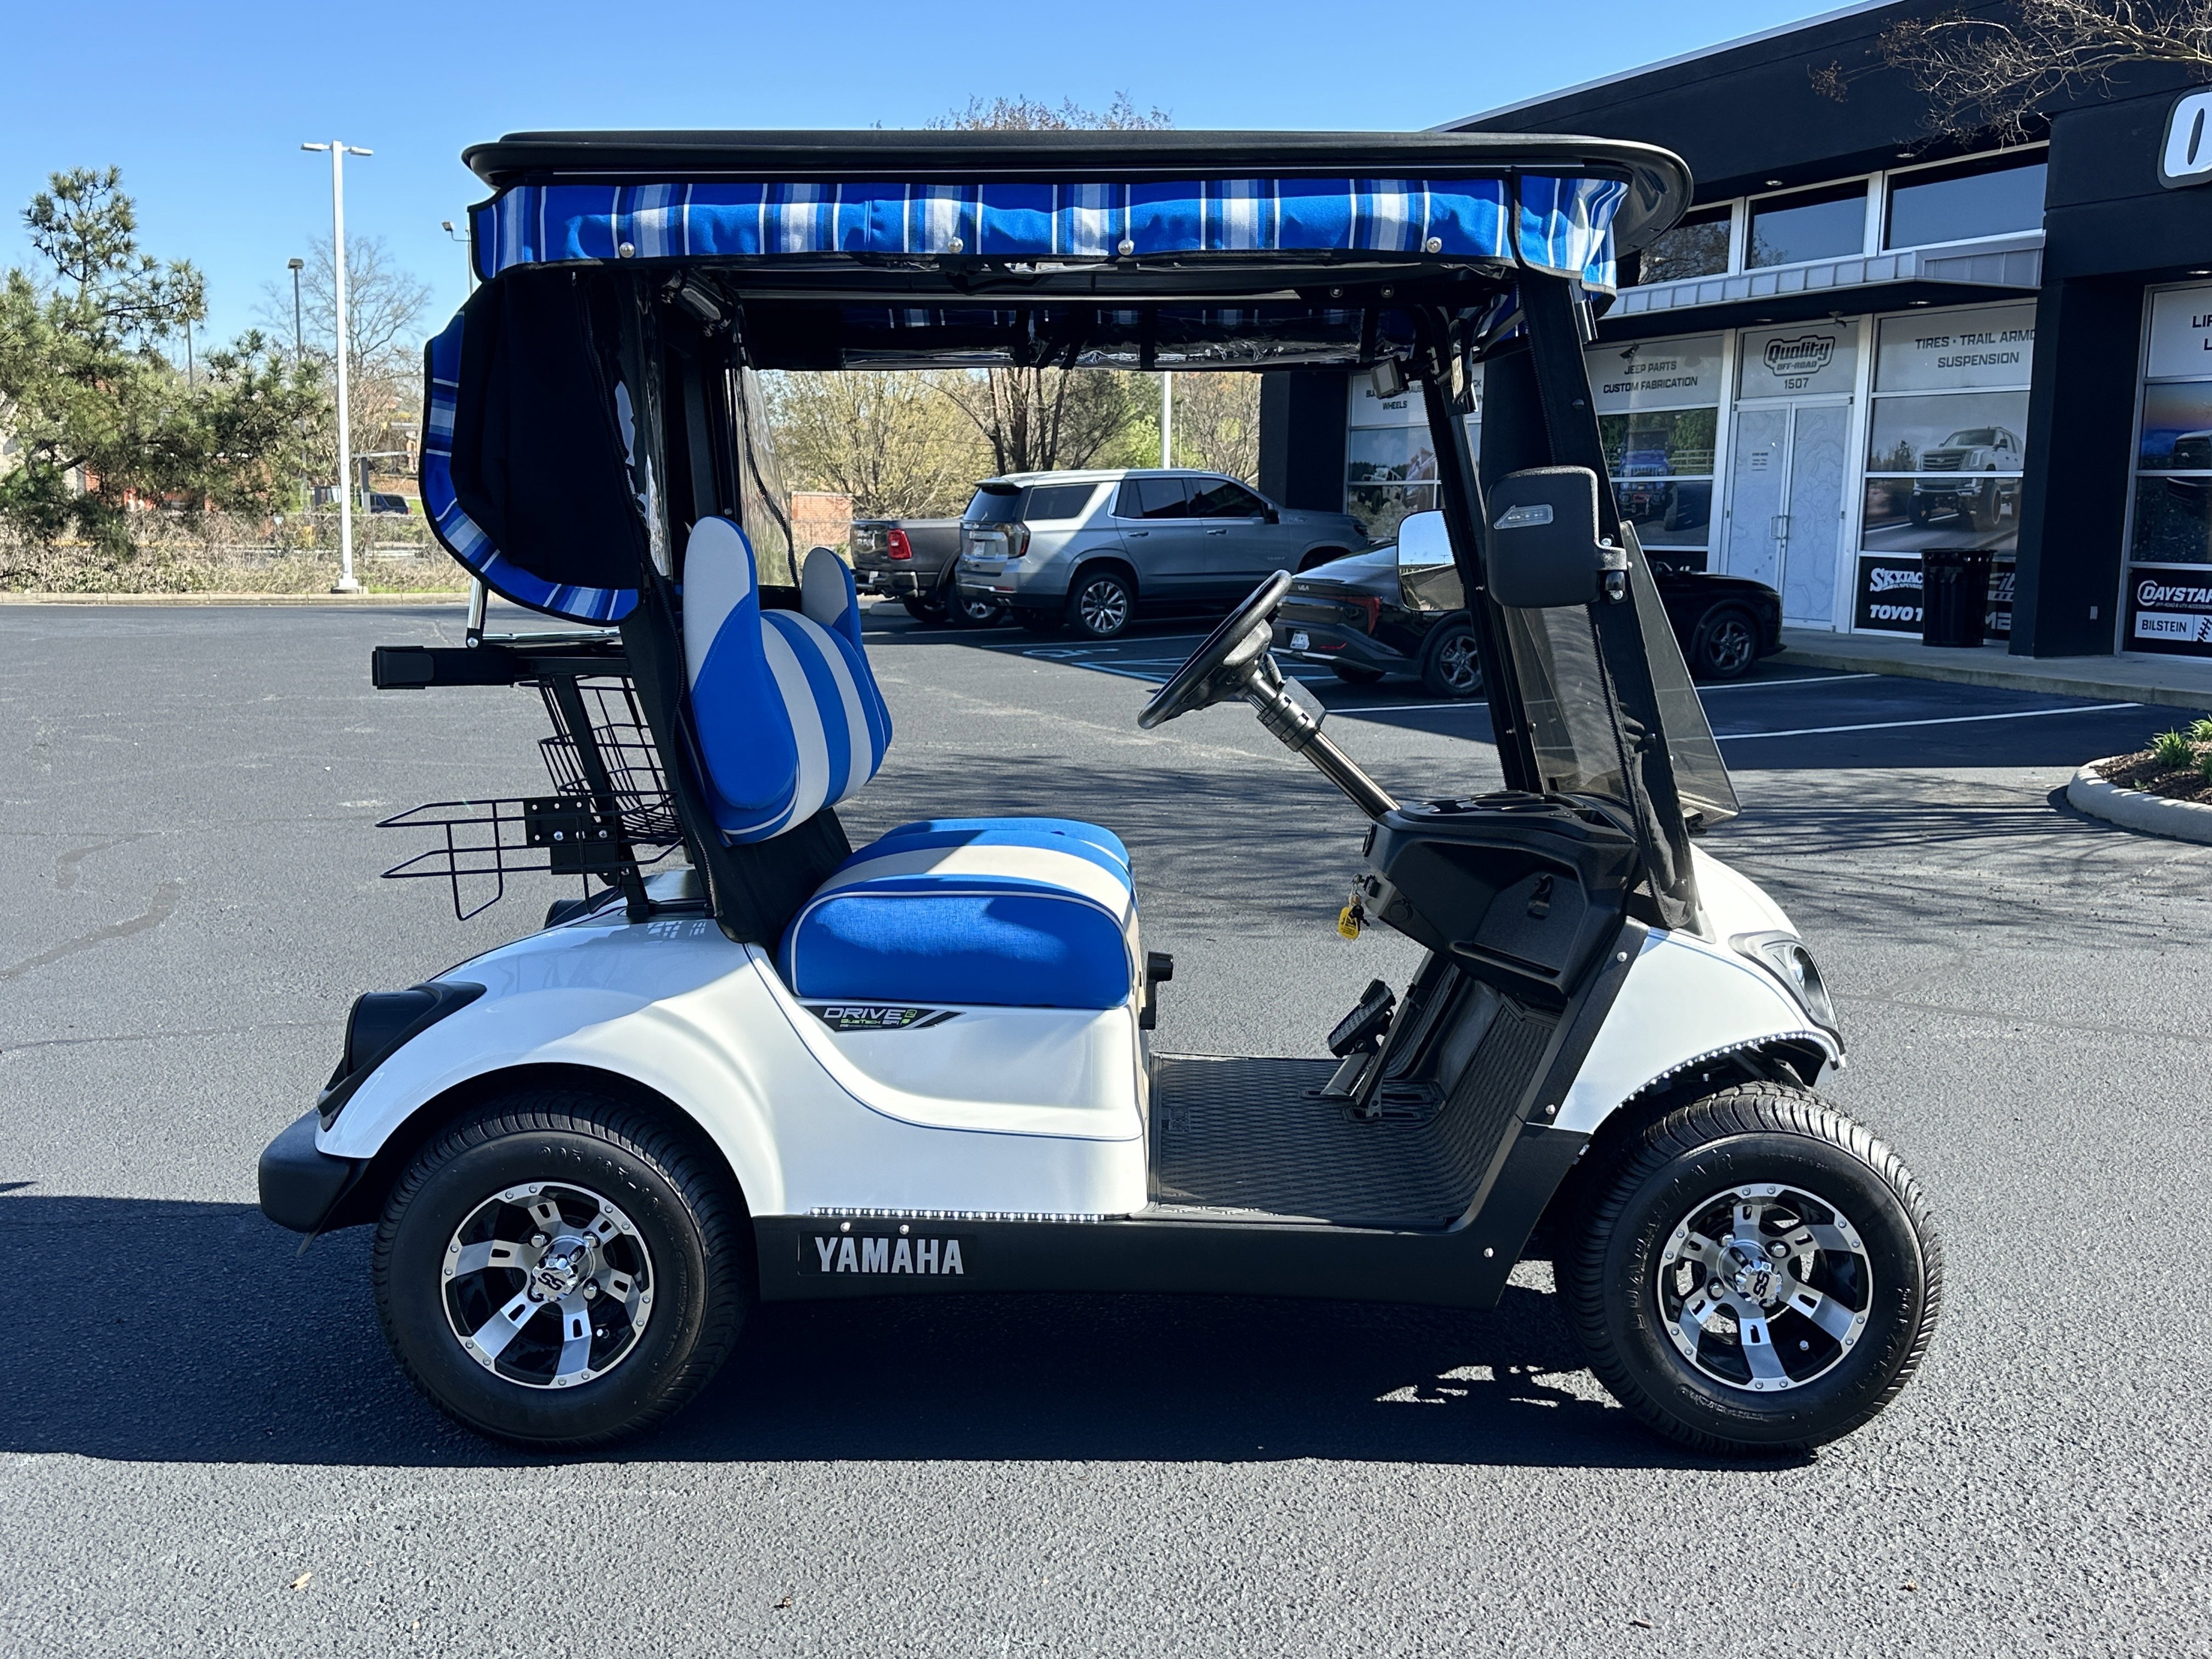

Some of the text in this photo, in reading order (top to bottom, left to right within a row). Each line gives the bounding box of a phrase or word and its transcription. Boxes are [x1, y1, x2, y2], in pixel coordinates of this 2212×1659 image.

[1915, 336, 1949, 349] TIRES
[1960, 332, 1995, 346] TRAIL
[1768, 342, 1830, 363] Quality
[1938, 352, 2019, 368] SUSPENSION
[1624, 361, 1677, 375] JEEP PARTS
[1777, 360, 1817, 370] OFF-ROAD
[1603, 376, 1698, 393] CUSTOM FABRICATION
[1784, 377, 1809, 389] 1507
[1383, 400, 1408, 410] WHEELS
[1870, 567, 1922, 592] SKYJAC
[1870, 605, 1914, 621] TOYO
[2142, 619, 2187, 633] BILSTEIN
[814, 1237, 964, 1274] YAMAHA
[538, 1272, 566, 1290] SS
